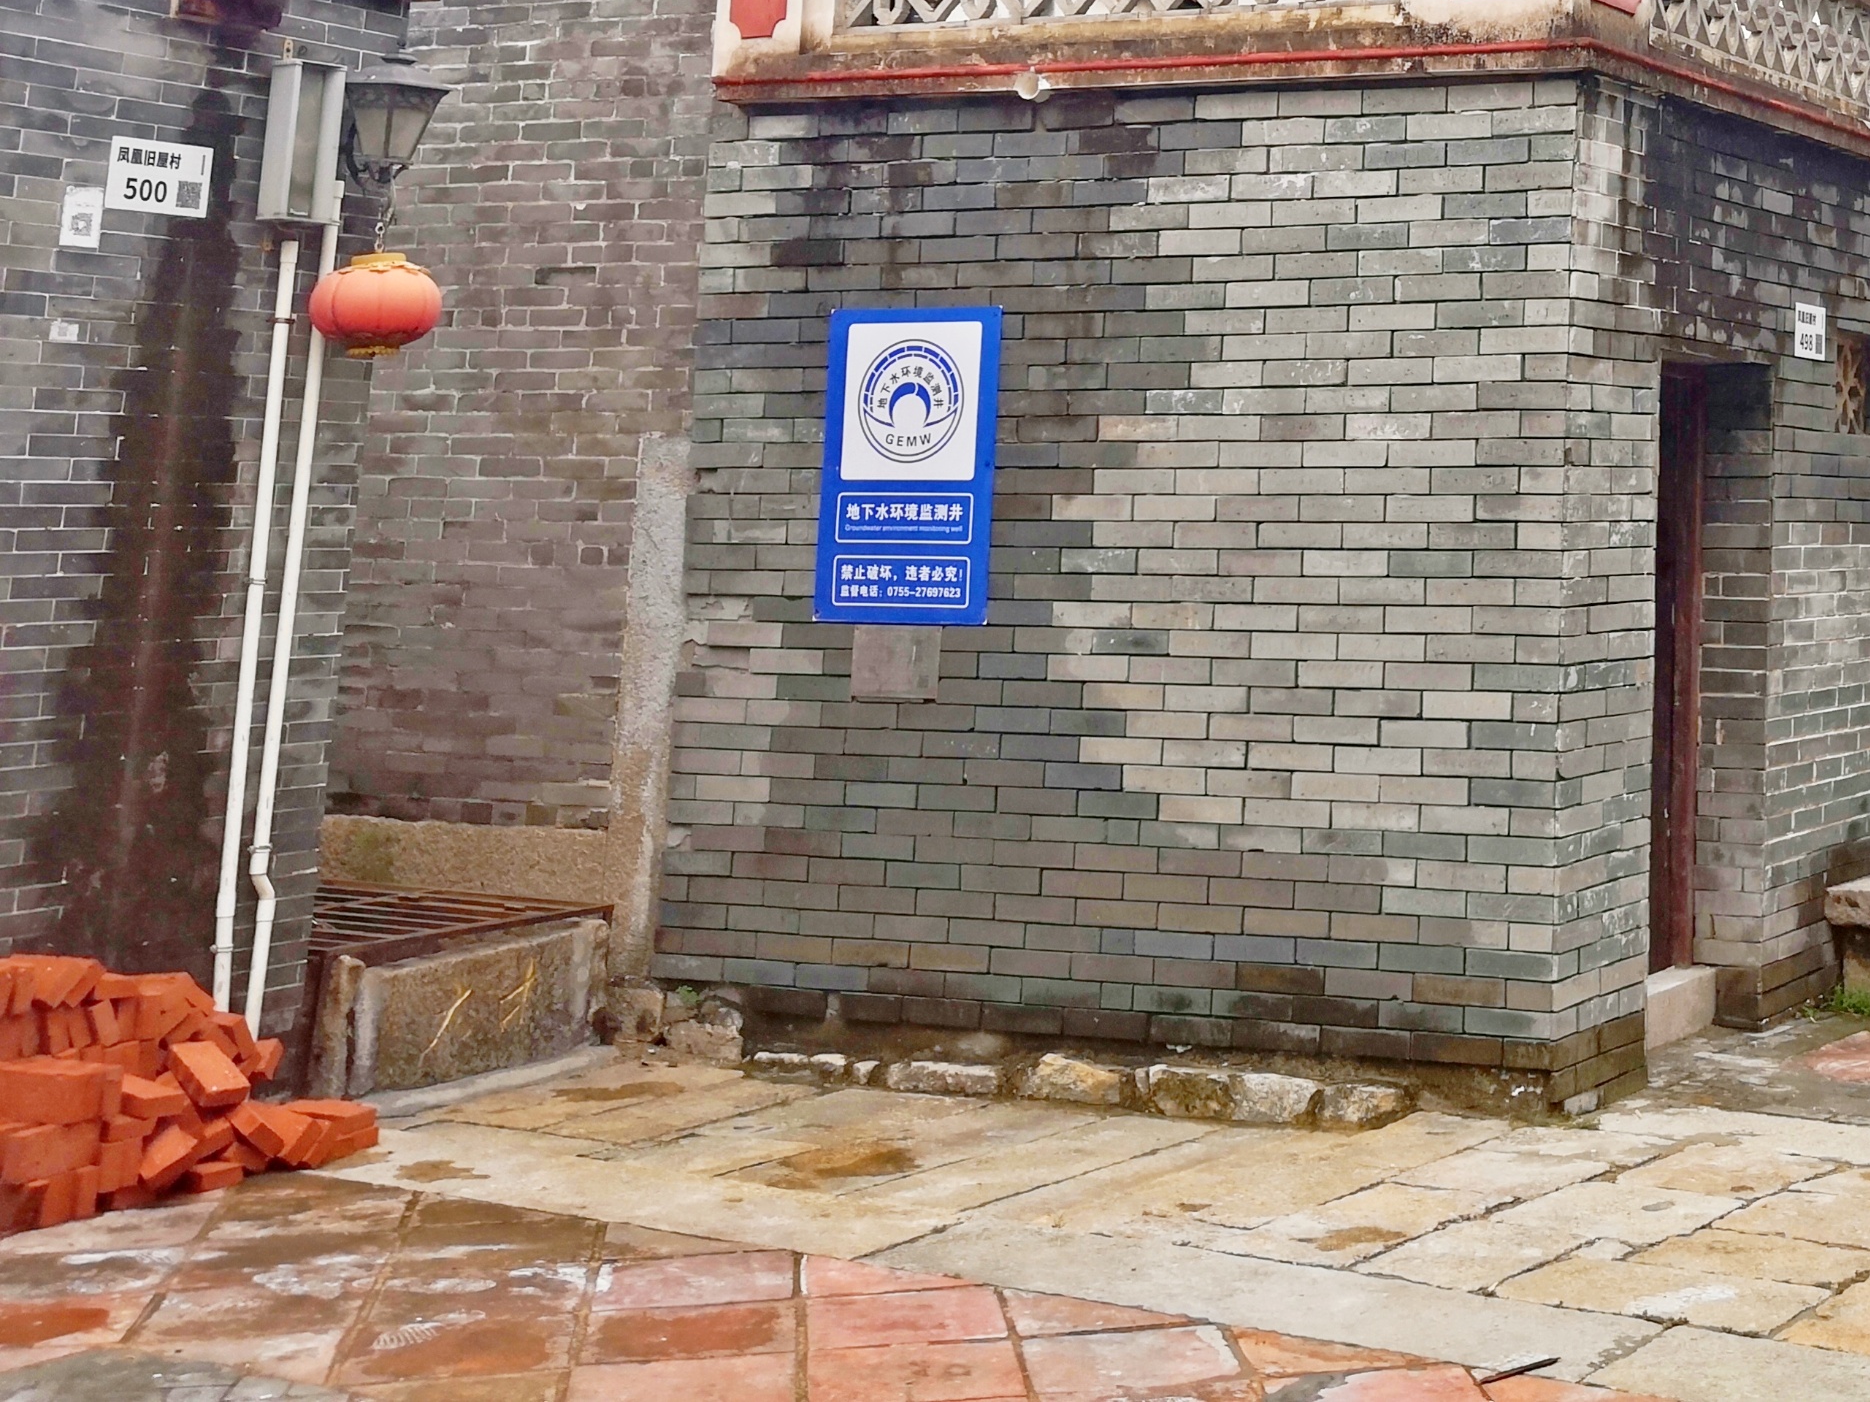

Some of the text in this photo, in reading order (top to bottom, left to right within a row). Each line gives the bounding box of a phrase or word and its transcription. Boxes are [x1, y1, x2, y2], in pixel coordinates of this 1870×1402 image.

[123, 177, 167, 203] 500
[1800, 333, 1813, 351] 498
[877, 365, 944, 409] 地下水环境监测井
[885, 433, 931, 447] GEMW
[846, 503, 963, 521] 地下水环境监测井
